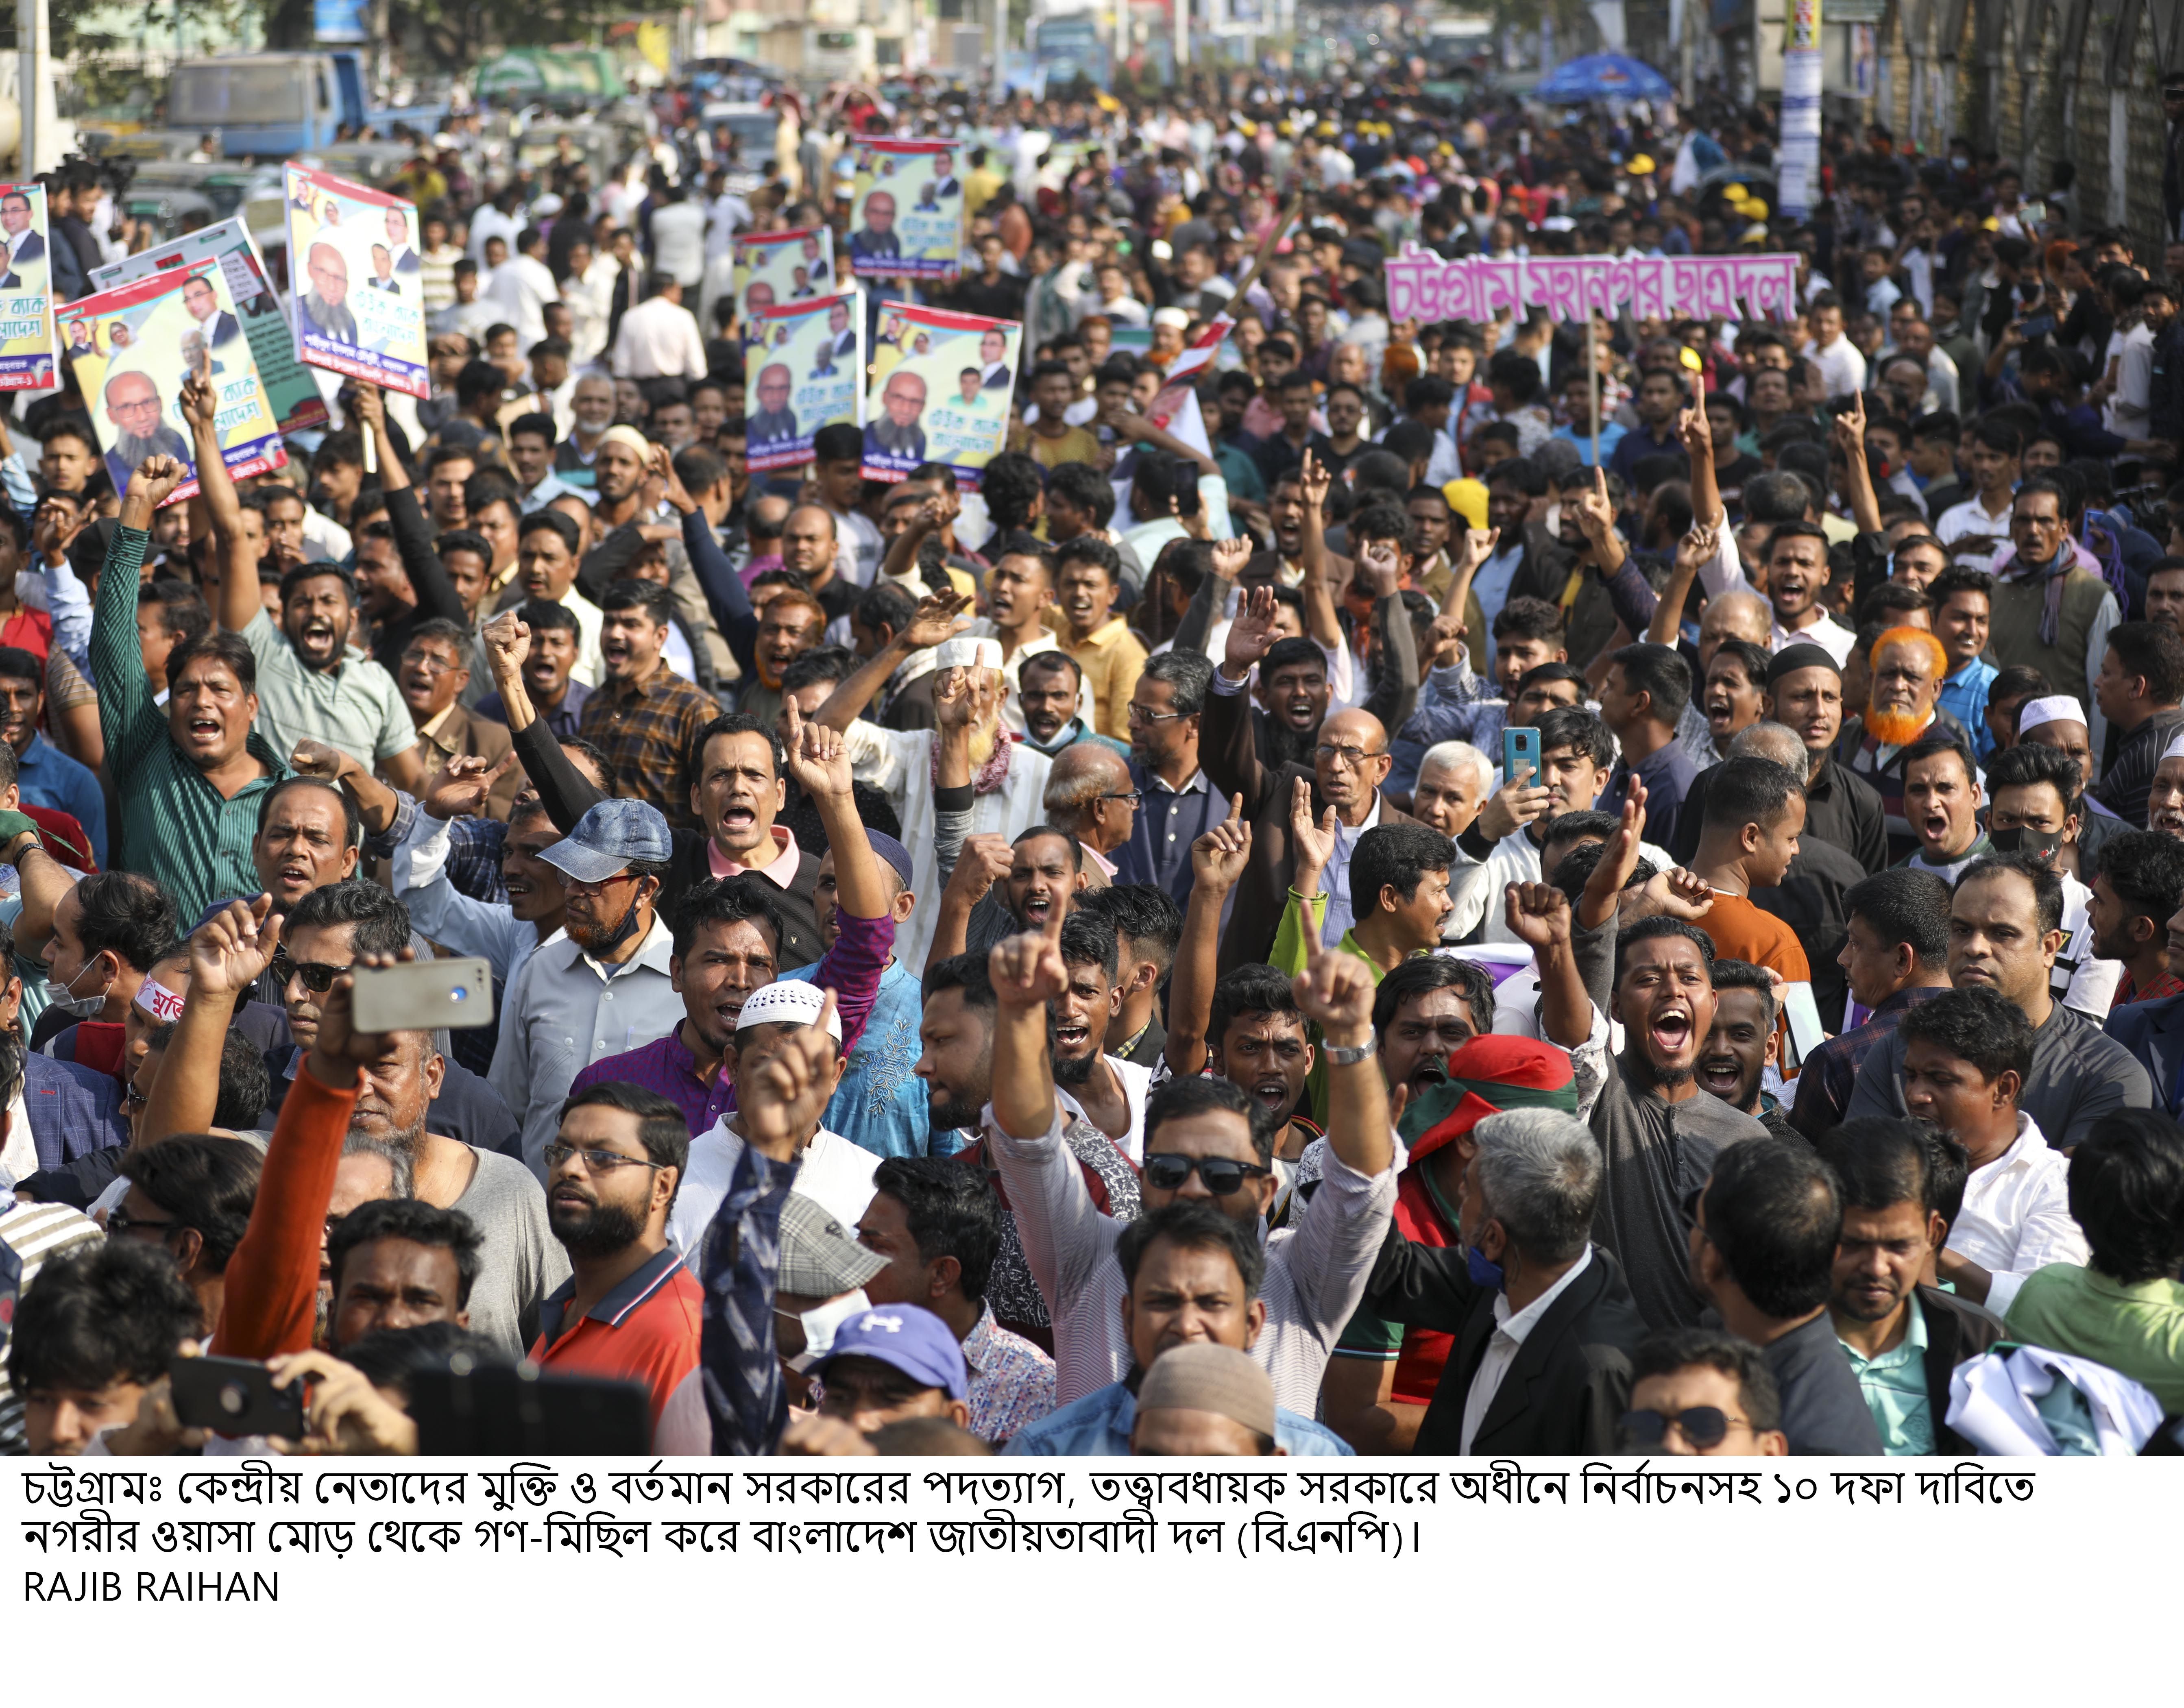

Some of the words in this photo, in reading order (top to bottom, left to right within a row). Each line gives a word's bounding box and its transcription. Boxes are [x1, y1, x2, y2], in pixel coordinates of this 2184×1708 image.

[1385, 241, 1528, 322] চট্টগ্রাম
[1527, 255, 1672, 322] মহানগর
[1670, 253, 1799, 322] ছাত্রদল
